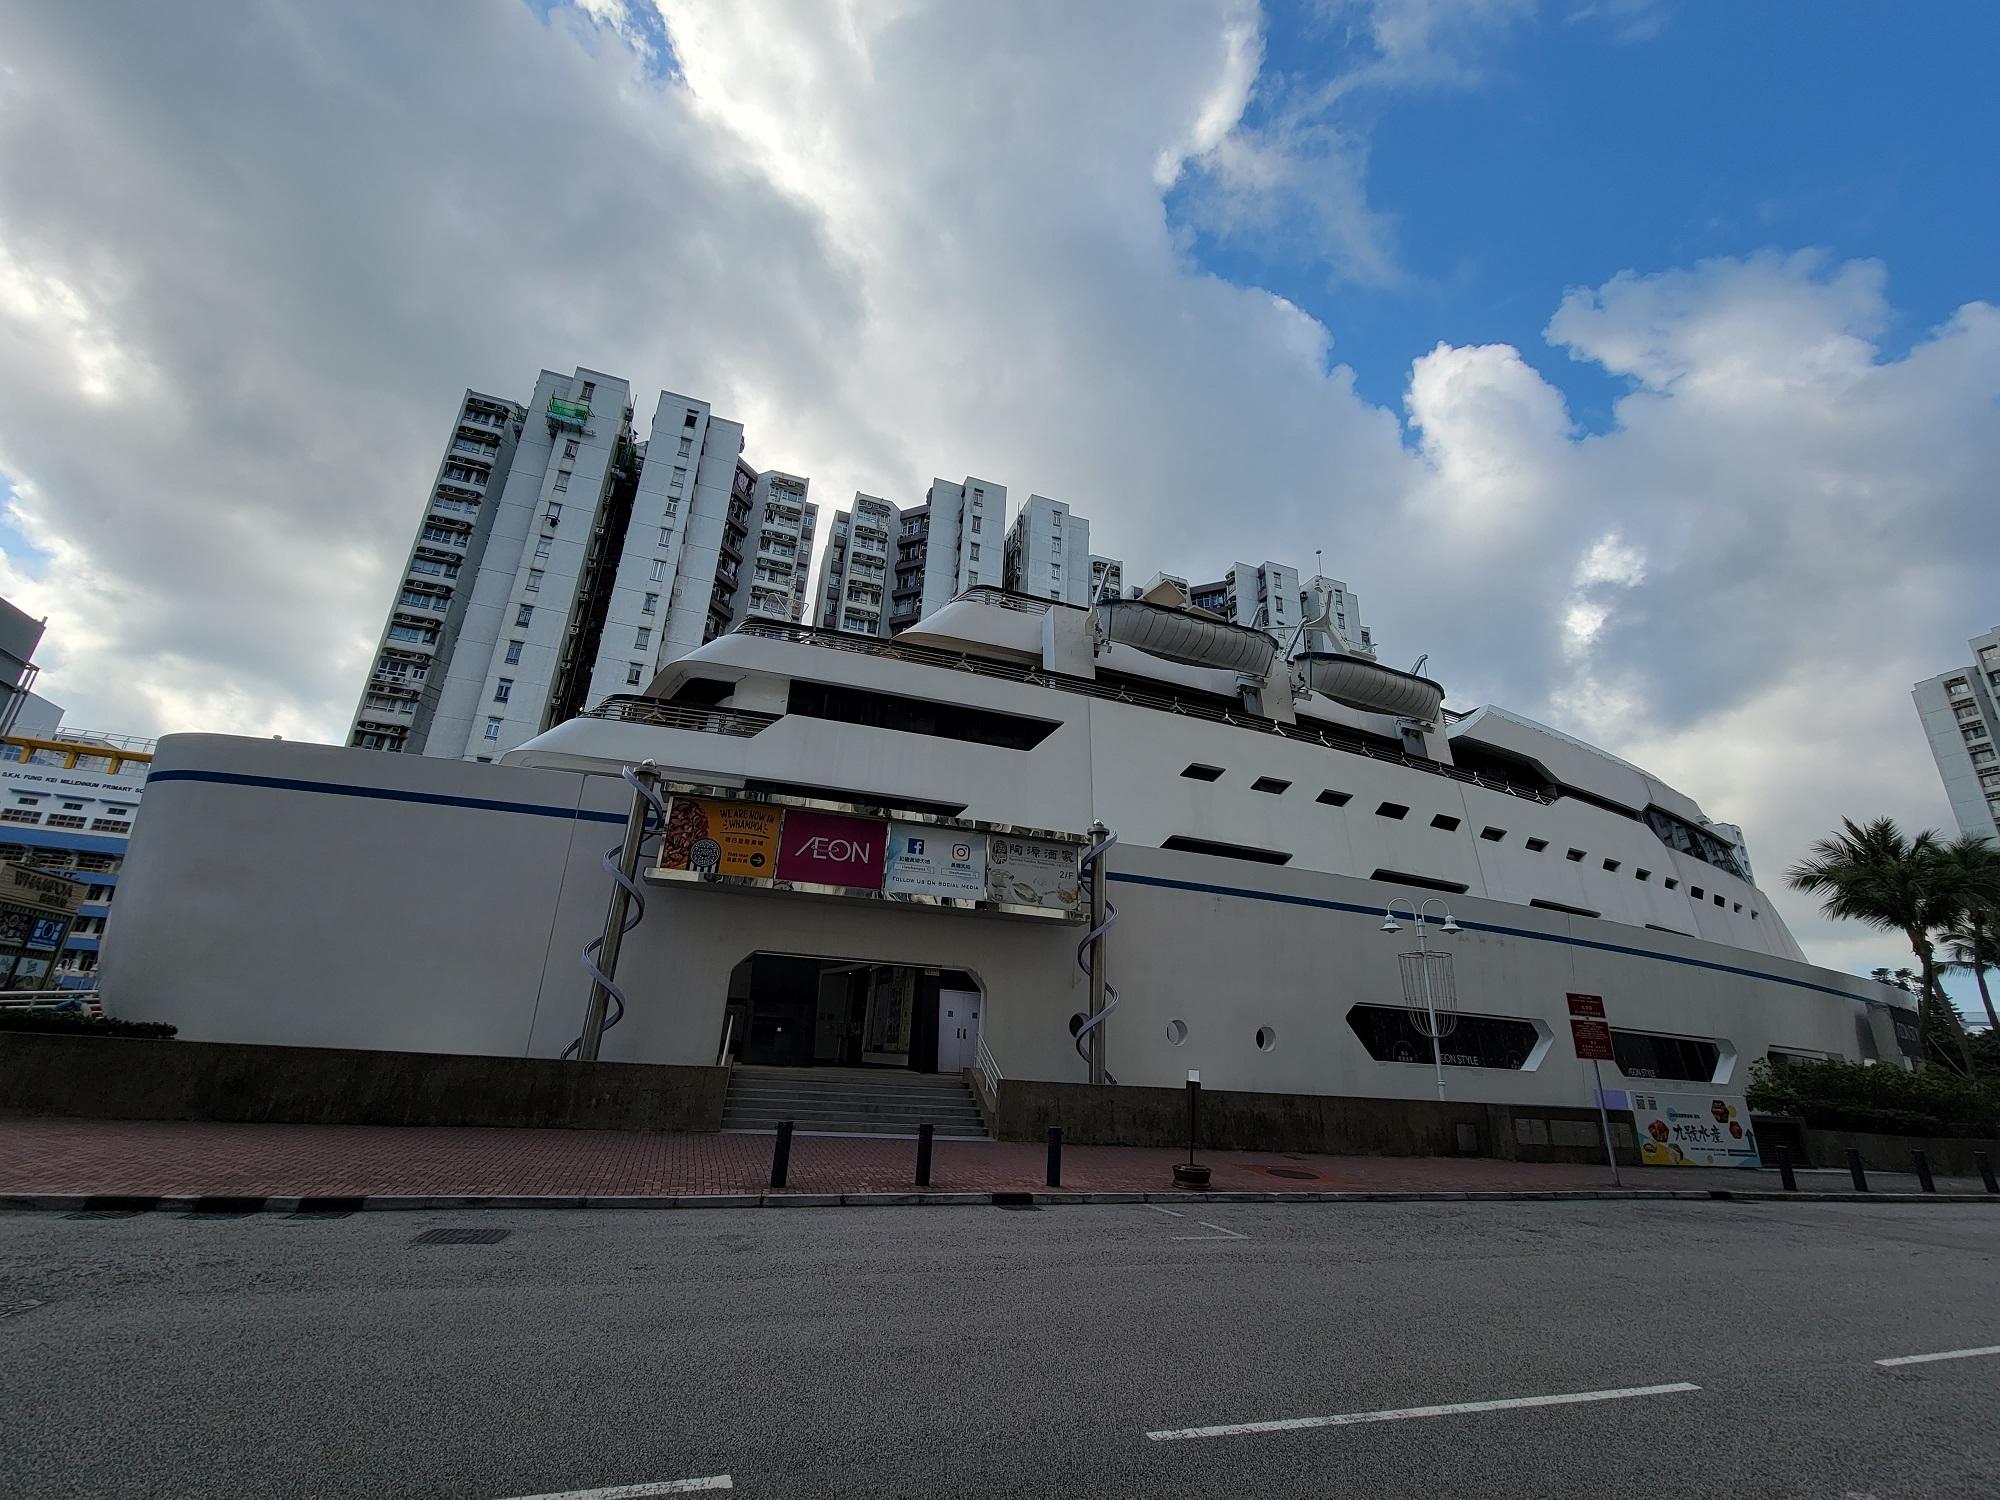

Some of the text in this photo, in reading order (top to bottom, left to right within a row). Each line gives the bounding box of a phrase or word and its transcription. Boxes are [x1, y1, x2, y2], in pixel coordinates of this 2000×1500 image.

[24, 774, 42, 782] FUNG
[60, 778, 100, 789] MILLENNIUM
[720, 808, 776, 825] WE ARE NOW IN
[728, 819, 763, 832] WHAMPOA
[1059, 870, 1075, 880] 2/F
[892, 876, 915, 885] FOLLOW
[927, 879, 936, 887] ON
[938, 881, 960, 889] SOCIAL
[1457, 1053, 1480, 1066] STYLE
